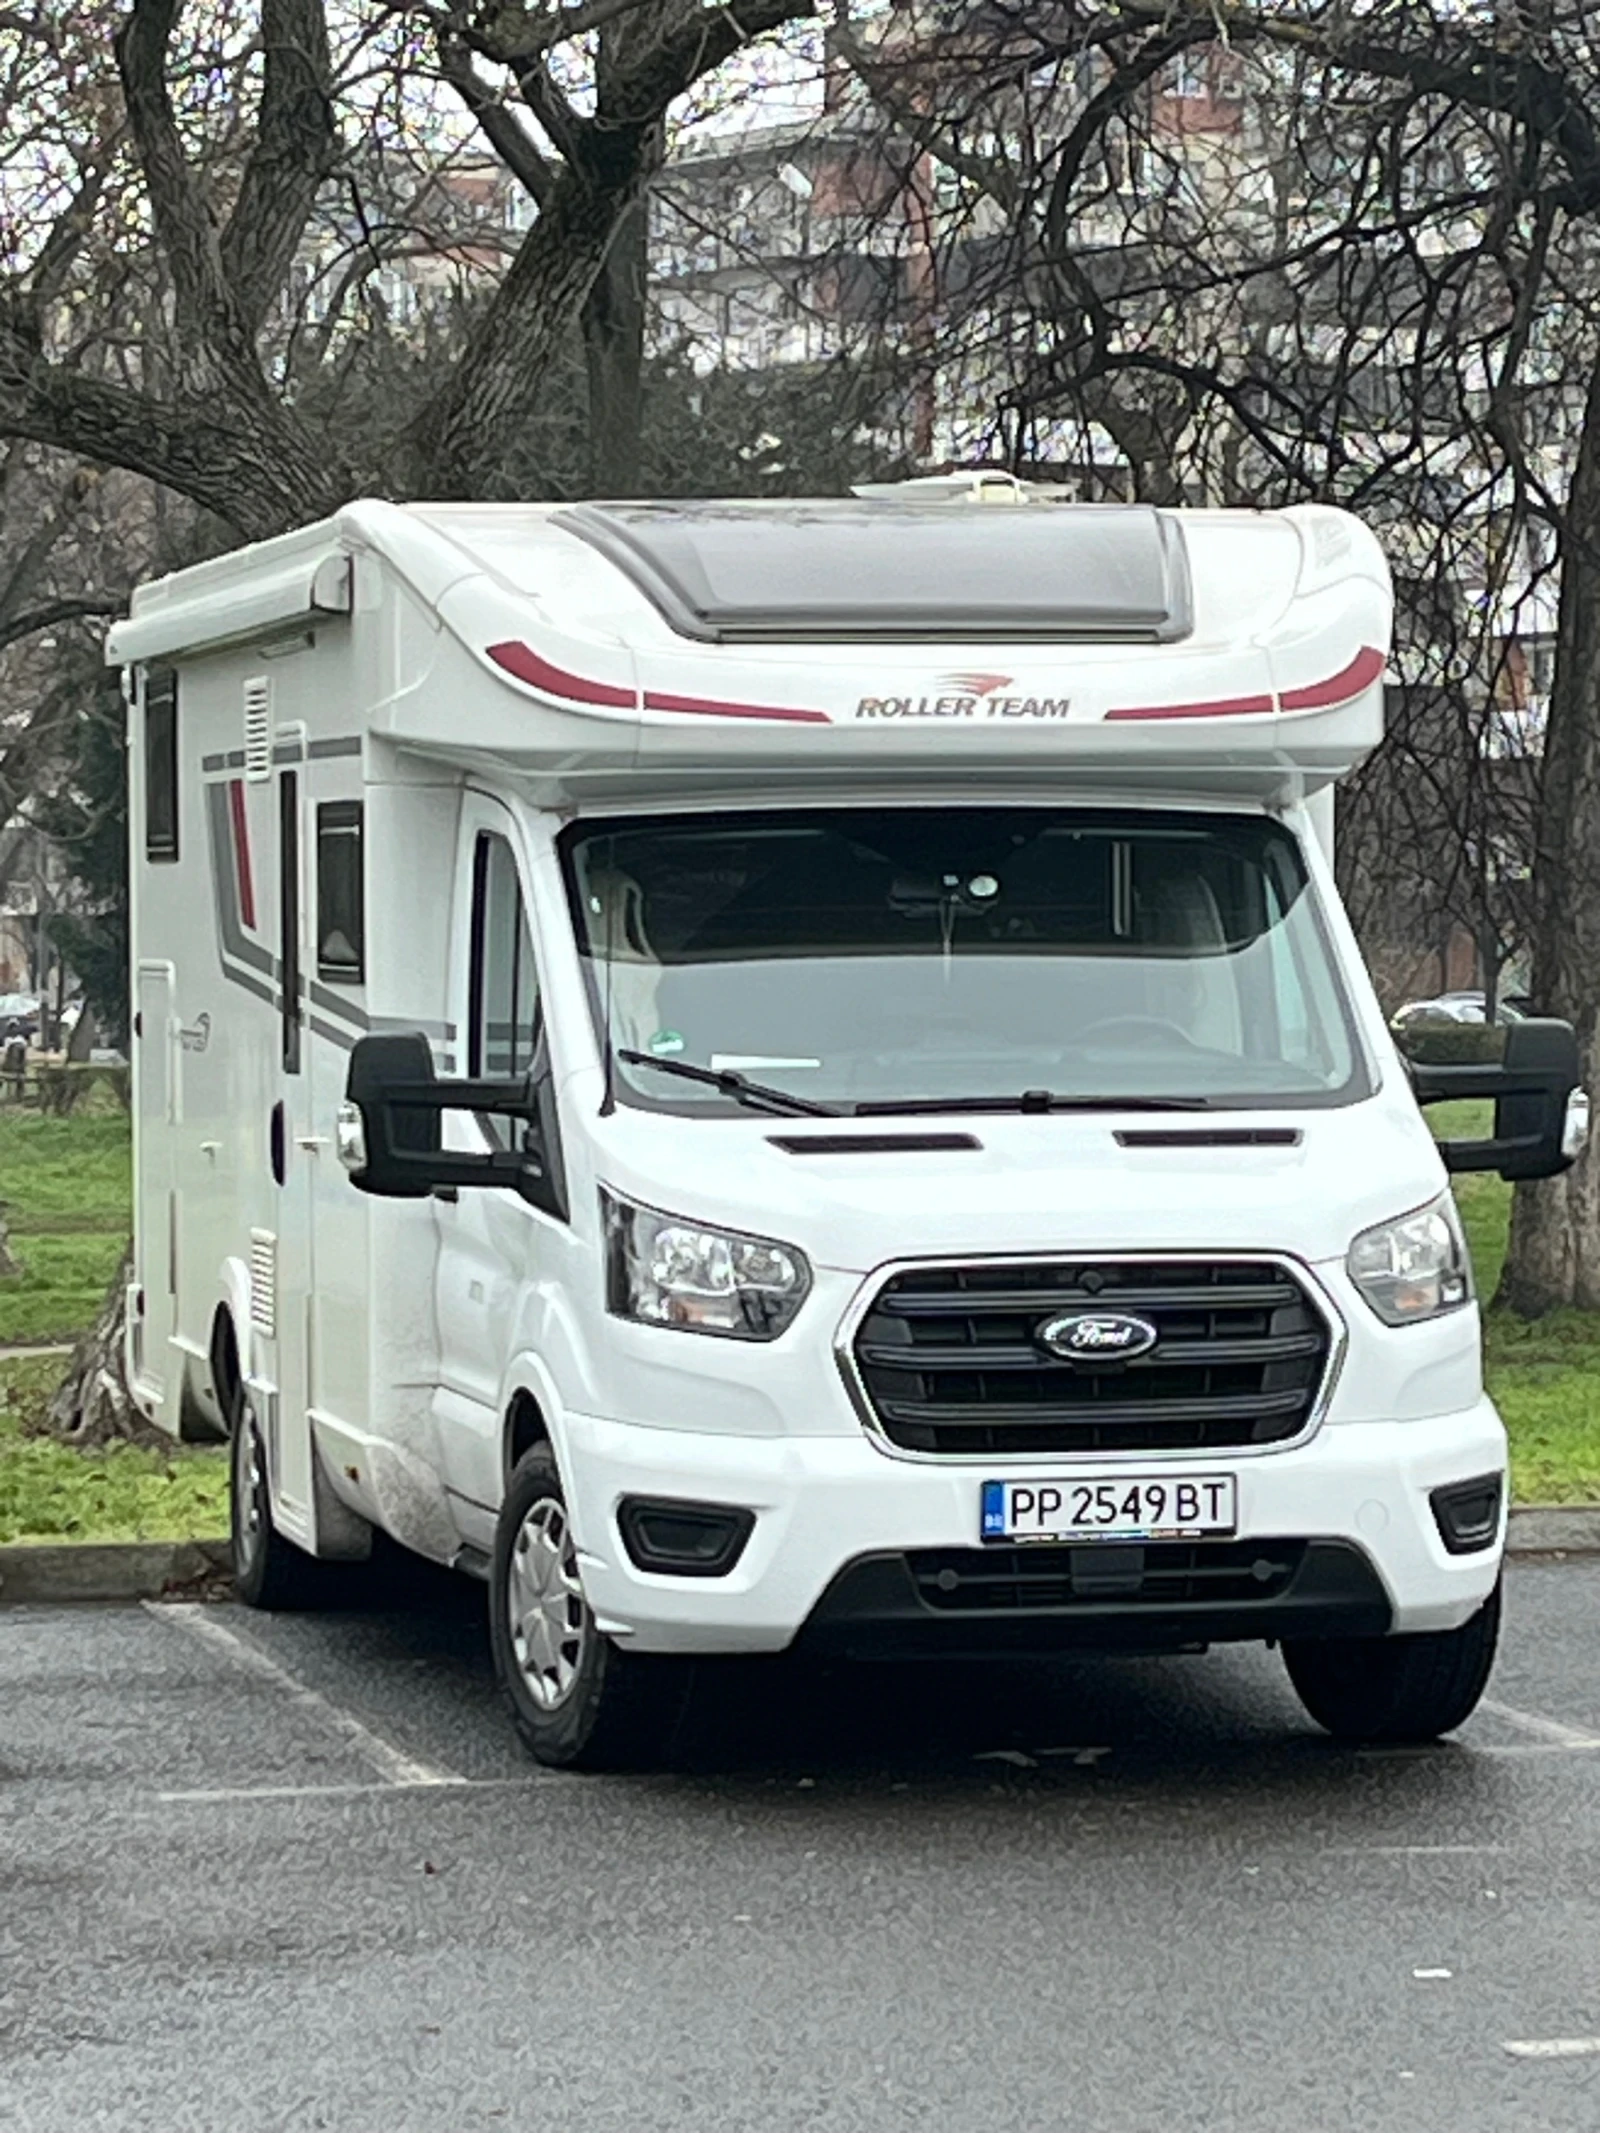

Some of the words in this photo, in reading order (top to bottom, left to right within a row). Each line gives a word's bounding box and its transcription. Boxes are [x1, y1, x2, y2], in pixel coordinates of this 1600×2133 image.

[855, 697, 976, 718] ROLLER
[986, 697, 1071, 718] TEAM
[1071, 1320, 1132, 1347] Ford
[1011, 1488, 1062, 1528] PP
[1071, 1485, 1167, 1525] 2549
[1176, 1482, 1227, 1522] BT
